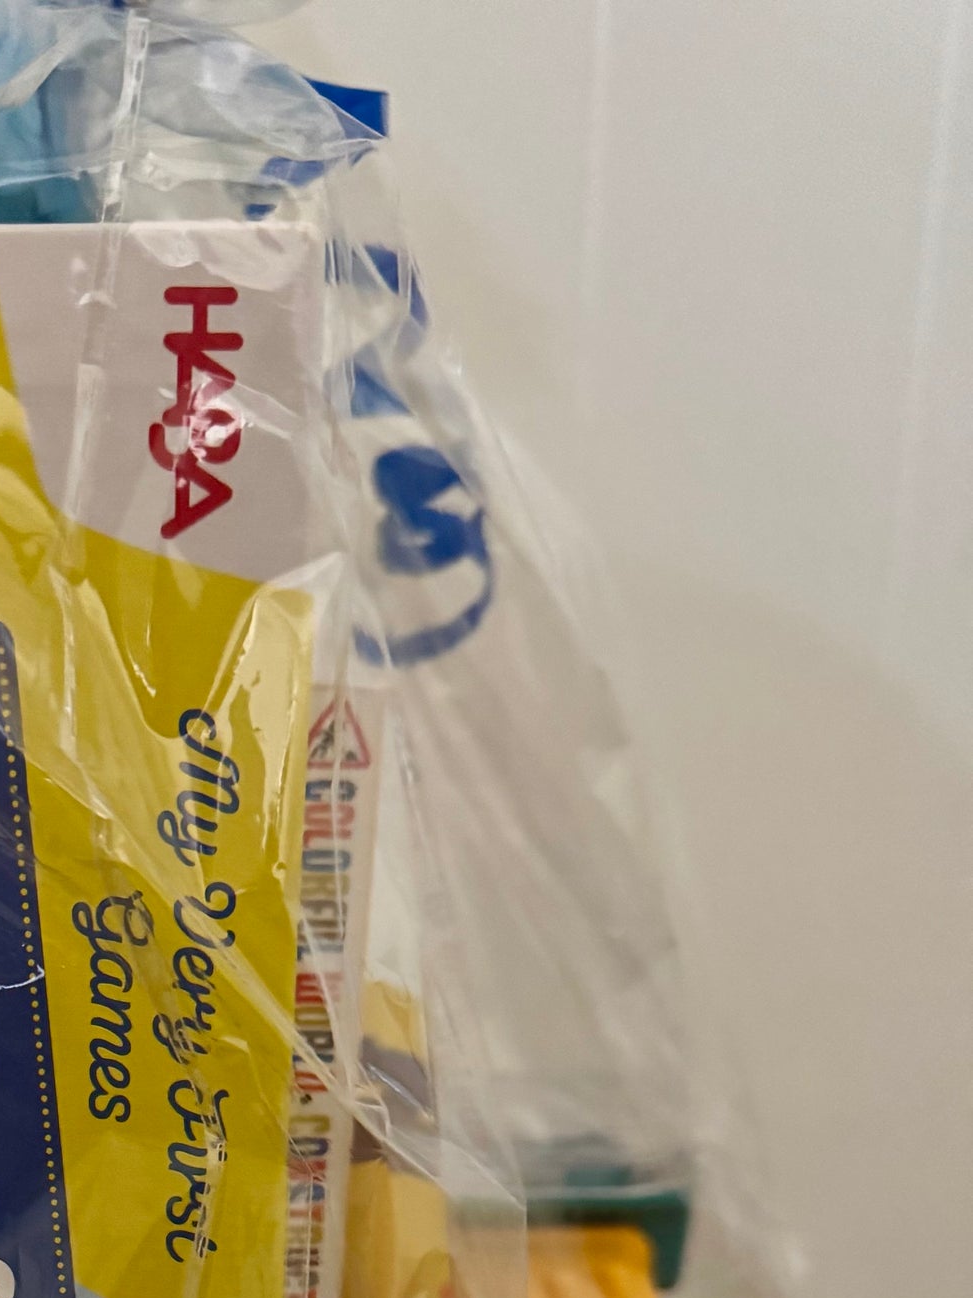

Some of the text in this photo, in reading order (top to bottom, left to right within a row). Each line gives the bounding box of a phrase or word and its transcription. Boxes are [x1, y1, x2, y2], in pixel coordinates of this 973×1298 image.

[153, 708, 240, 1264] My Very First
[297, 779, 356, 962] COLORFUL
[71, 890, 153, 1123] Games
